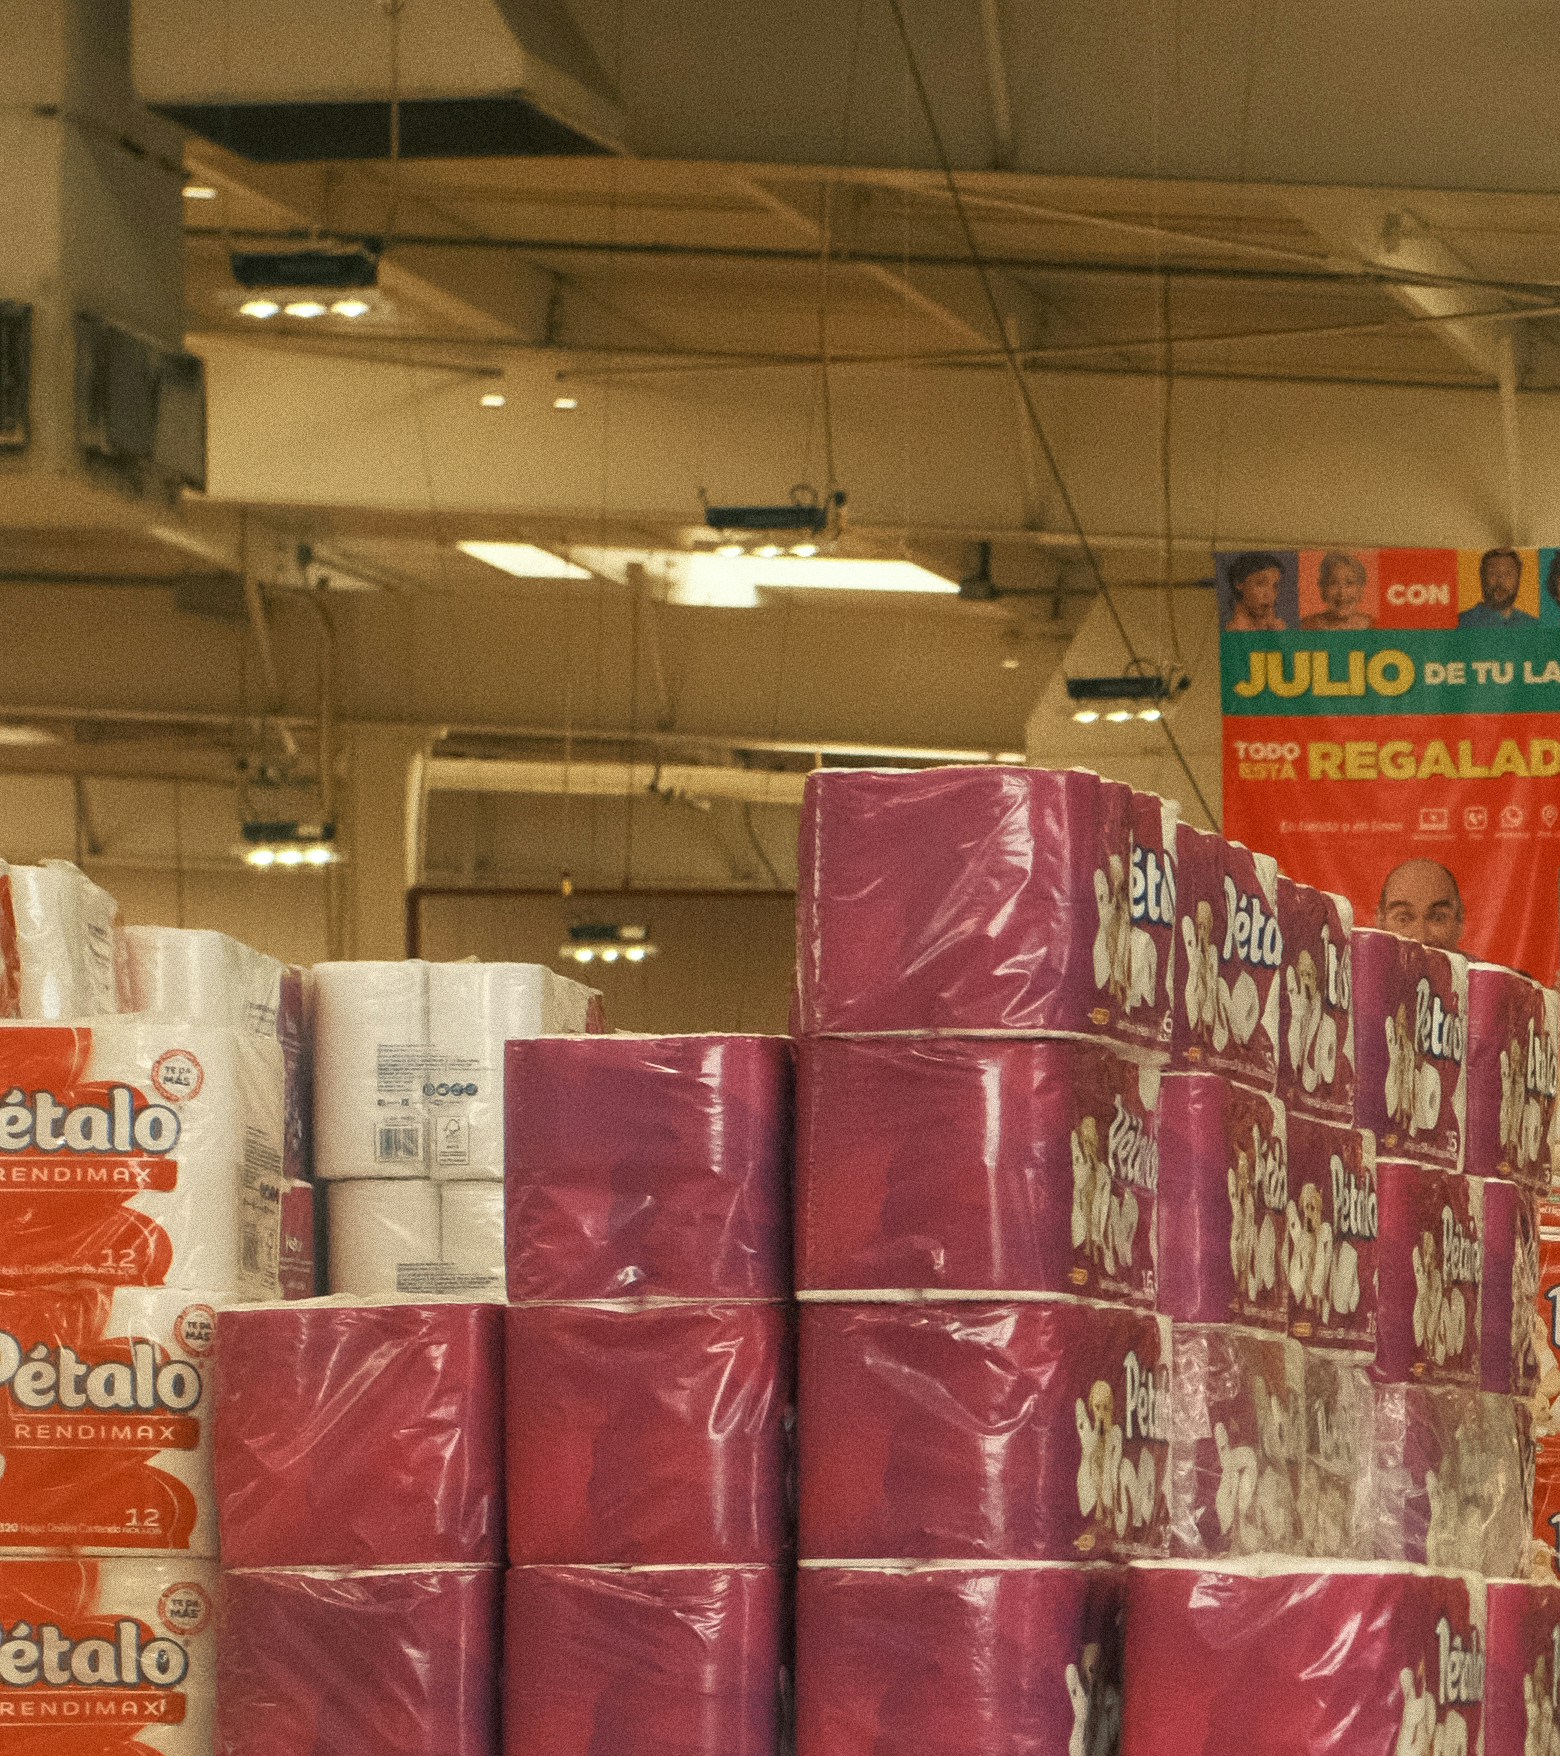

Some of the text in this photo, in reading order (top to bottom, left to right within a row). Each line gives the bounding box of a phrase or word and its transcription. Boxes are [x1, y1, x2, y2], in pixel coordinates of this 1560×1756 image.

[1387, 584, 1449, 605] CON
[1234, 649, 1415, 698] JULIO
[1424, 663, 1466, 685] DE
[1472, 662, 1514, 684] TU
[1234, 741, 1300, 760] TODO
[15, 1424, 175, 1442] RENDIMAX
[0, 1620, 188, 1687] étalo
